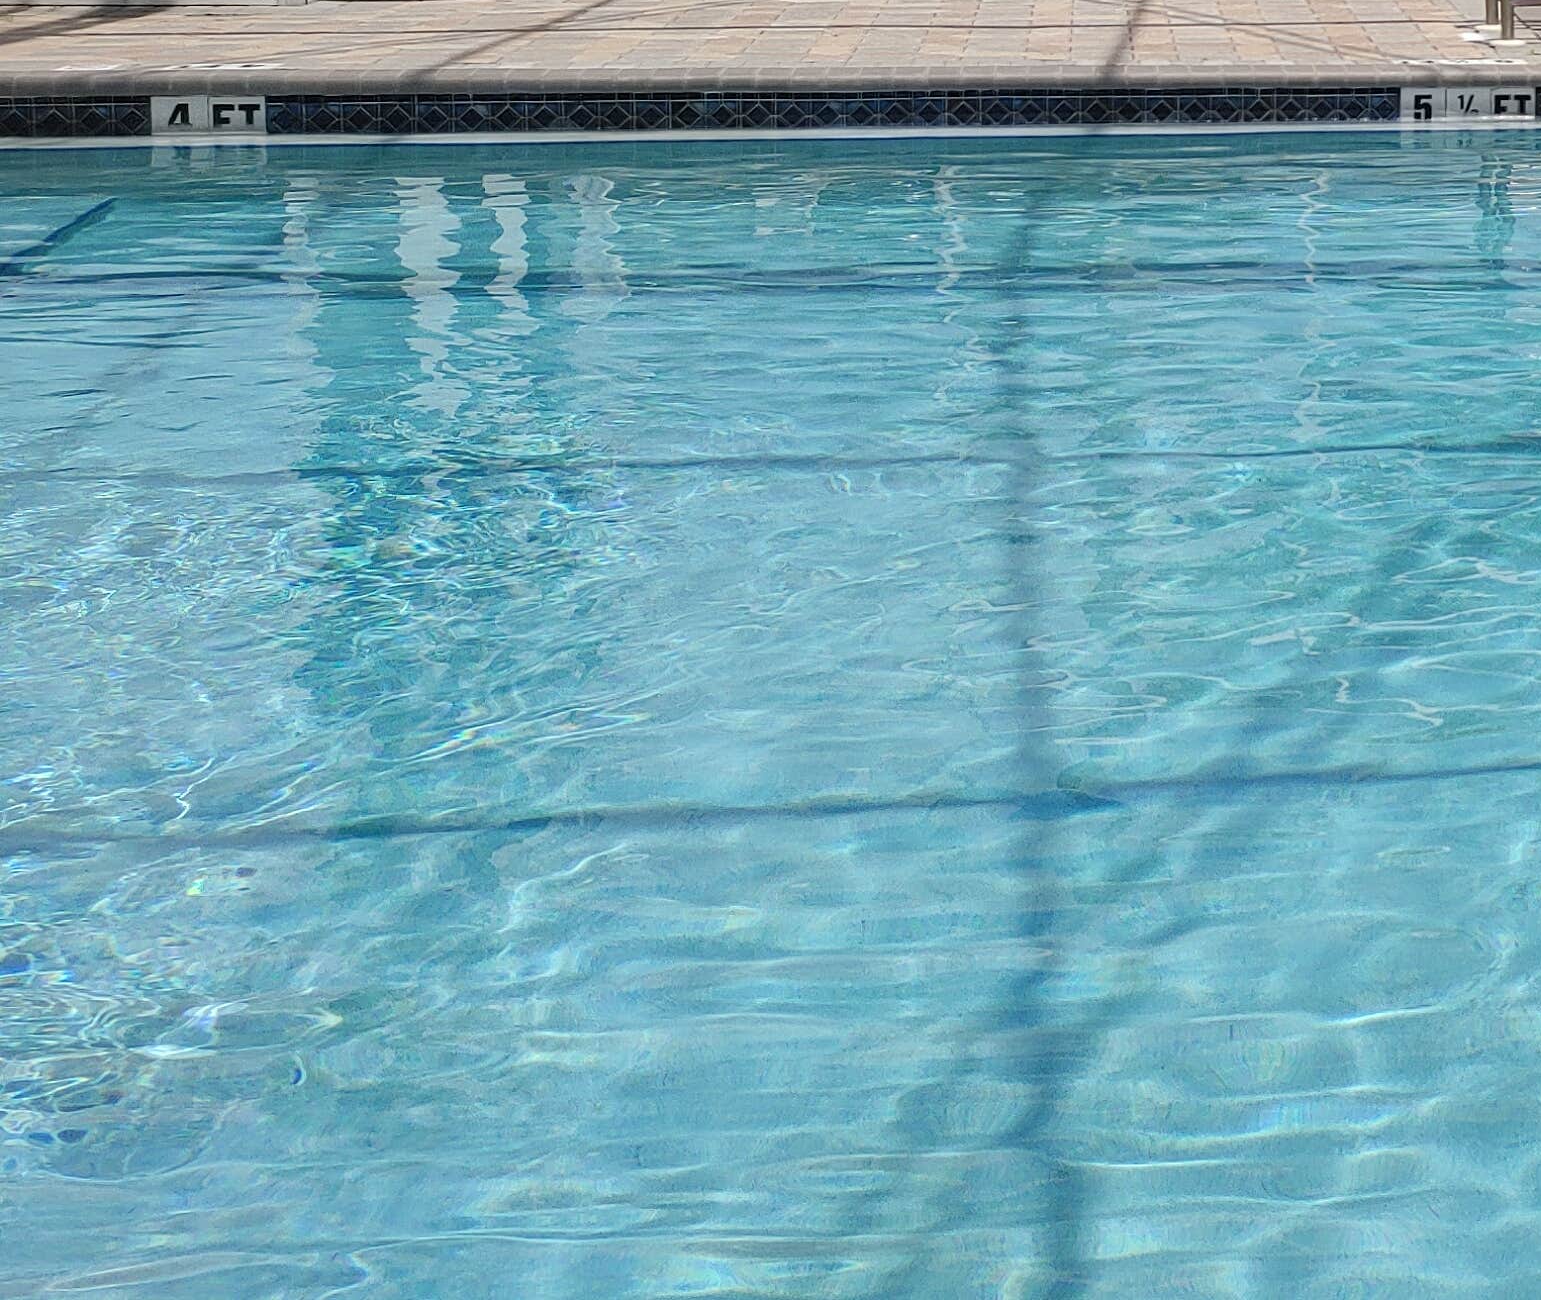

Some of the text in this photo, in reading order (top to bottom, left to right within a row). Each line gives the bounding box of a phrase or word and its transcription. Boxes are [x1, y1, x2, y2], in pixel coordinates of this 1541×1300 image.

[167, 103, 261, 128] 4 FT
[1413, 94, 1432, 120] 5
[1494, 93, 1532, 116] FT
